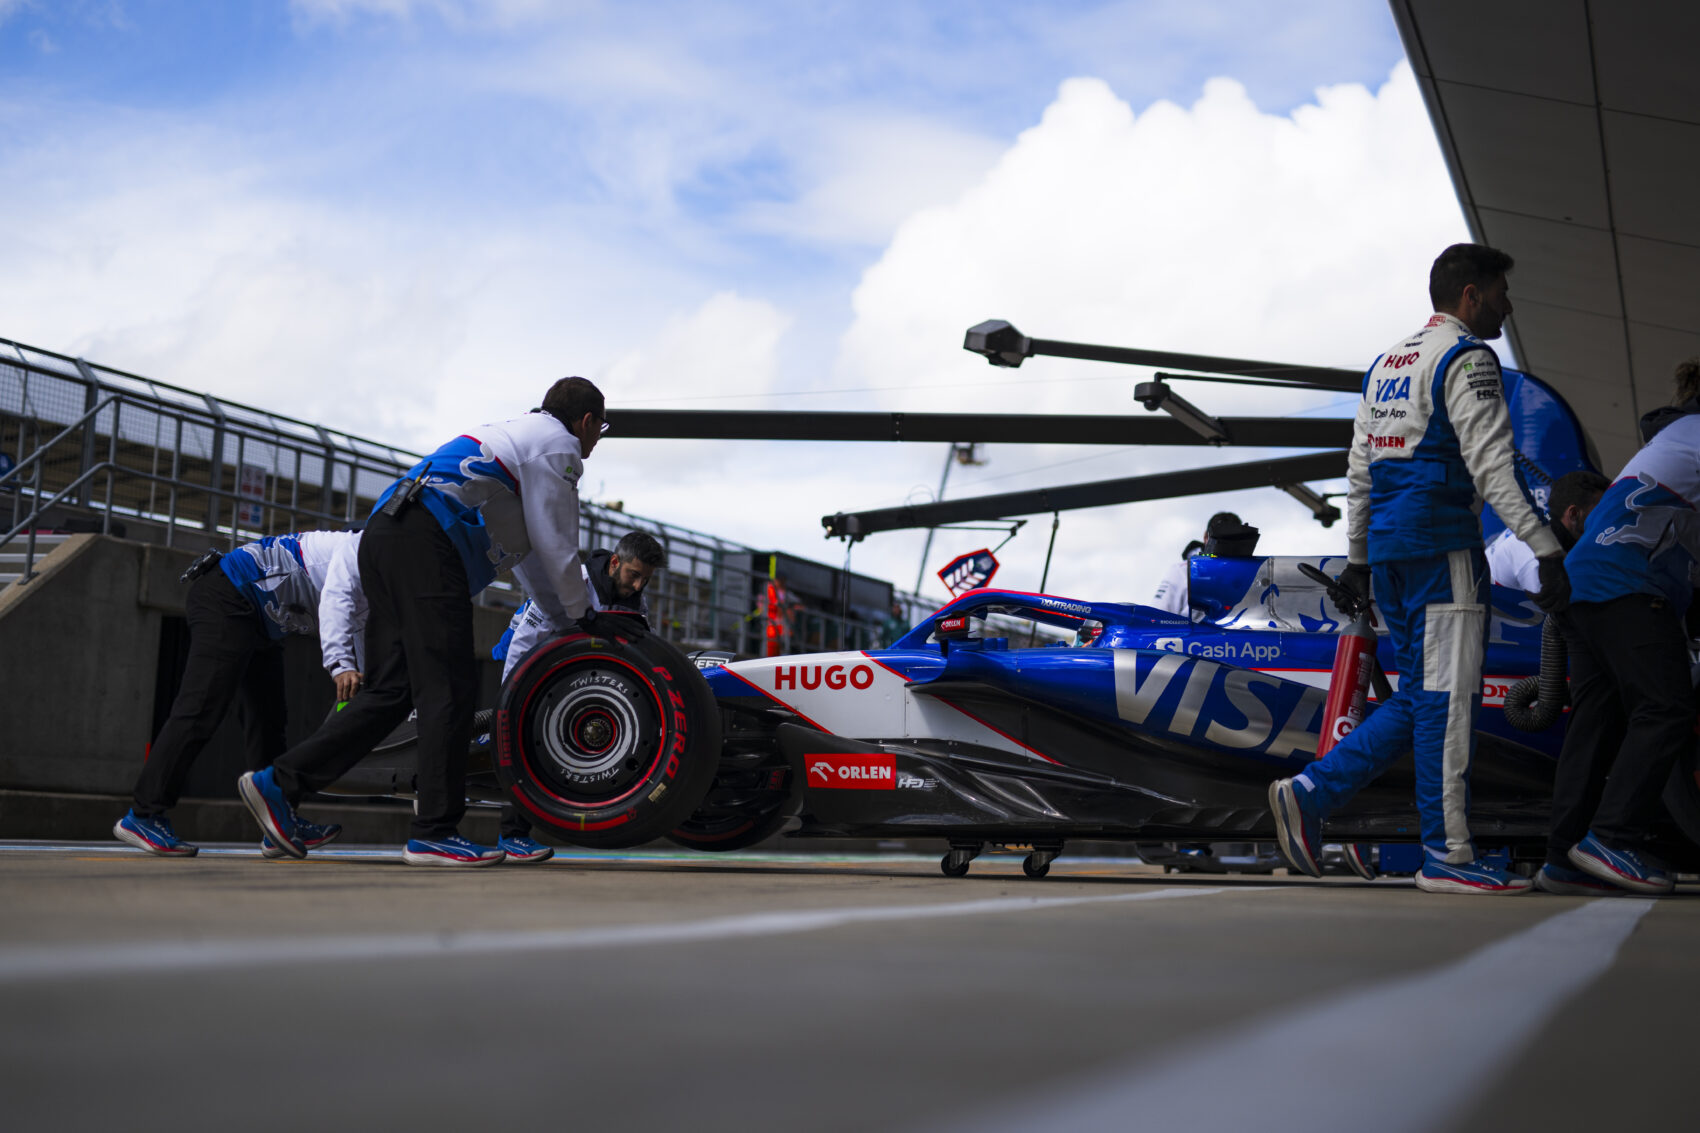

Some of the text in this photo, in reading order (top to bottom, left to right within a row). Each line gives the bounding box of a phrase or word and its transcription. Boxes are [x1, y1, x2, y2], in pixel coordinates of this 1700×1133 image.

[1188, 641, 1281, 662] Cash App
[695, 659, 726, 670] EFT
[570, 675, 629, 695] TWISTERS
[774, 664, 875, 691] HUGO
[1113, 650, 1330, 760] VISA
[652, 666, 688, 780] P ZERO
[561, 767, 620, 784] TWISTERS
[837, 765, 892, 780] ORLEN
